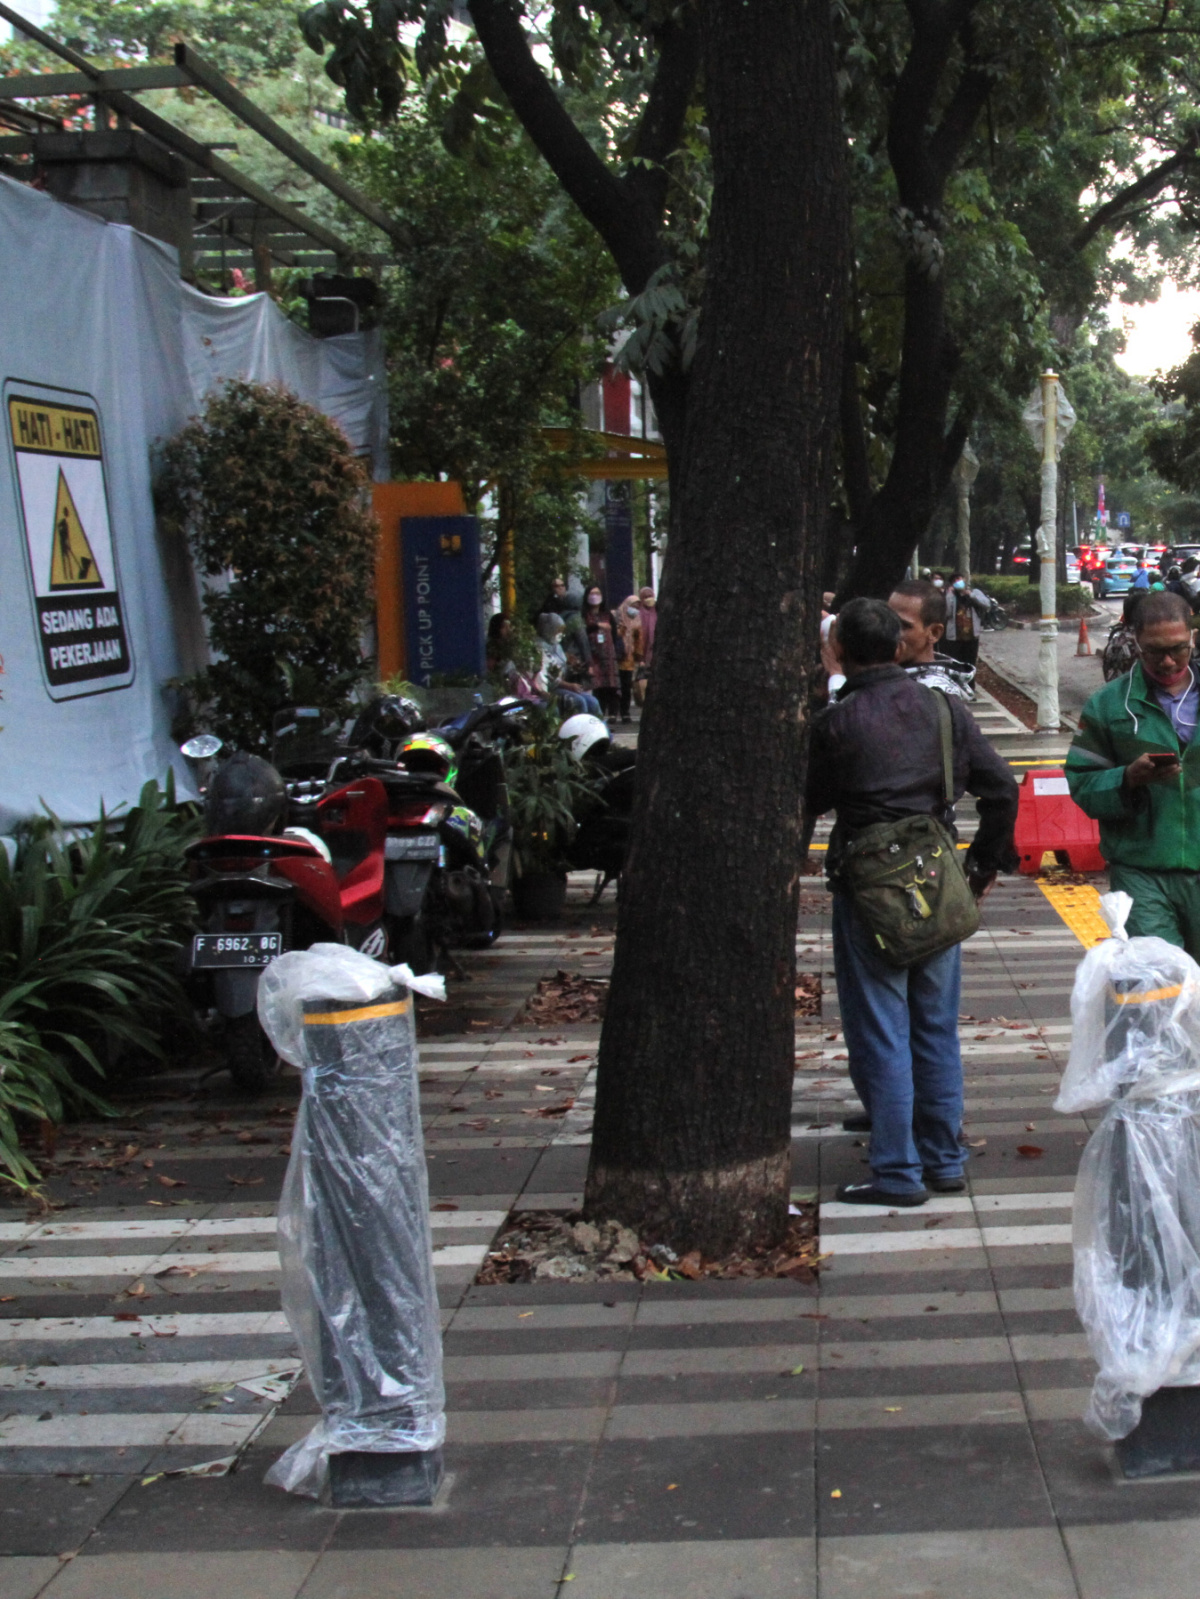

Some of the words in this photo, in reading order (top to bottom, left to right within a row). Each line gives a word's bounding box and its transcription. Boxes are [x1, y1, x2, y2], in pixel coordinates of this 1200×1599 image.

[415, 556, 431, 604] POINT
[42, 608, 94, 634] SEDANG
[96, 606, 119, 628] ADA
[418, 610, 432, 630] UP
[50, 639, 121, 669] PEKERJAAN
[420, 634, 434, 669] PICK
[197, 938, 205, 951] F
[217, 938, 249, 951] 6962
